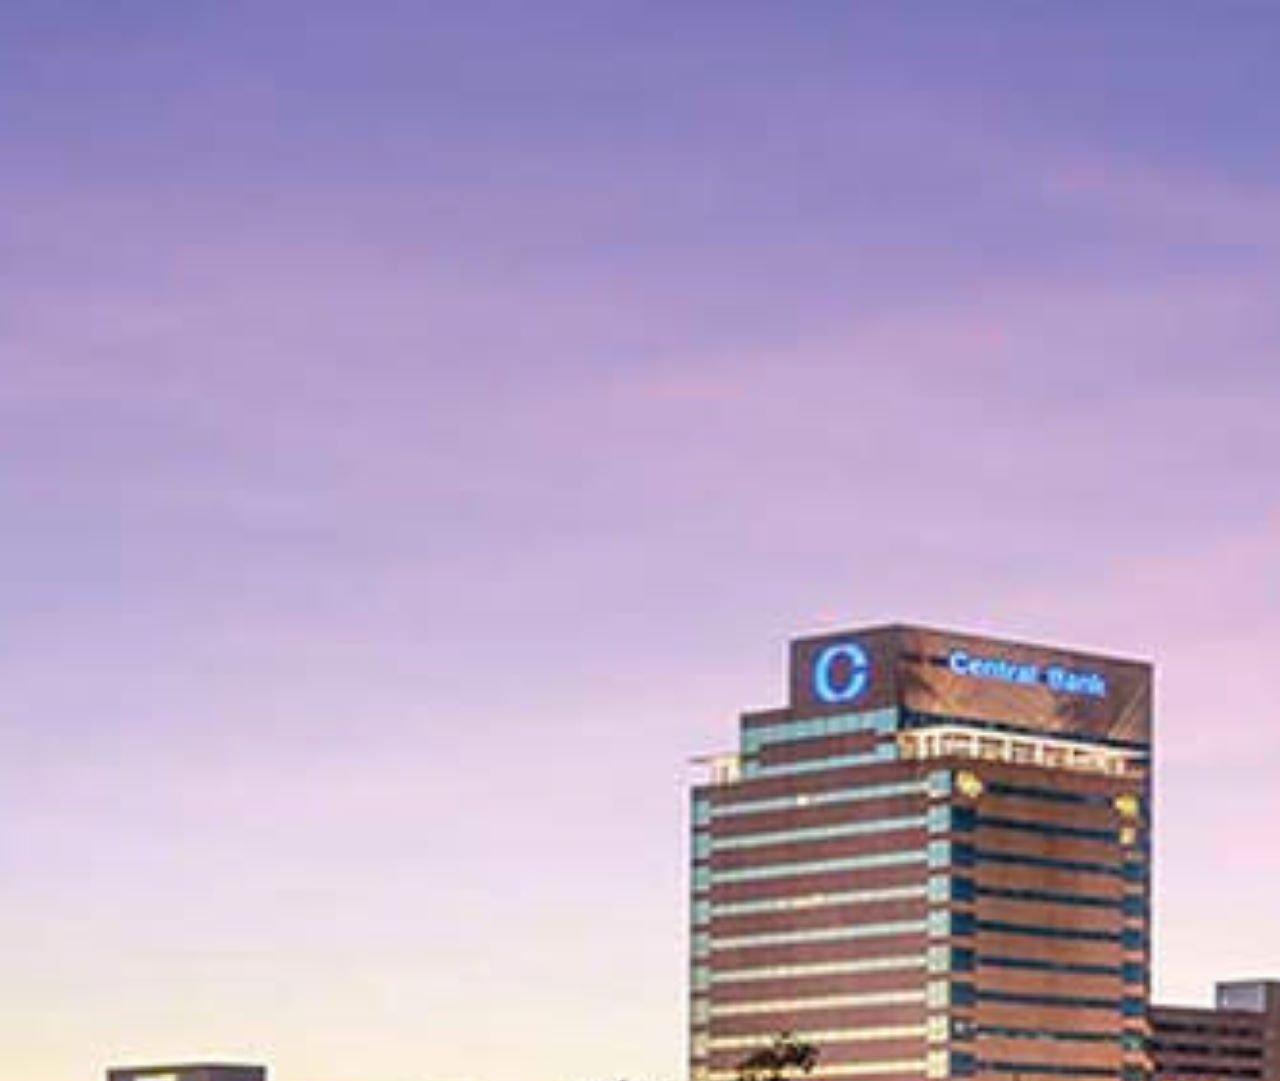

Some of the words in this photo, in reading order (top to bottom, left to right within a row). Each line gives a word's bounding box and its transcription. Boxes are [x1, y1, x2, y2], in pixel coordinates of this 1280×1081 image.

[814, 643, 868, 702] C
[950, 650, 1038, 684] Central
[1047, 665, 1106, 697] Bank
